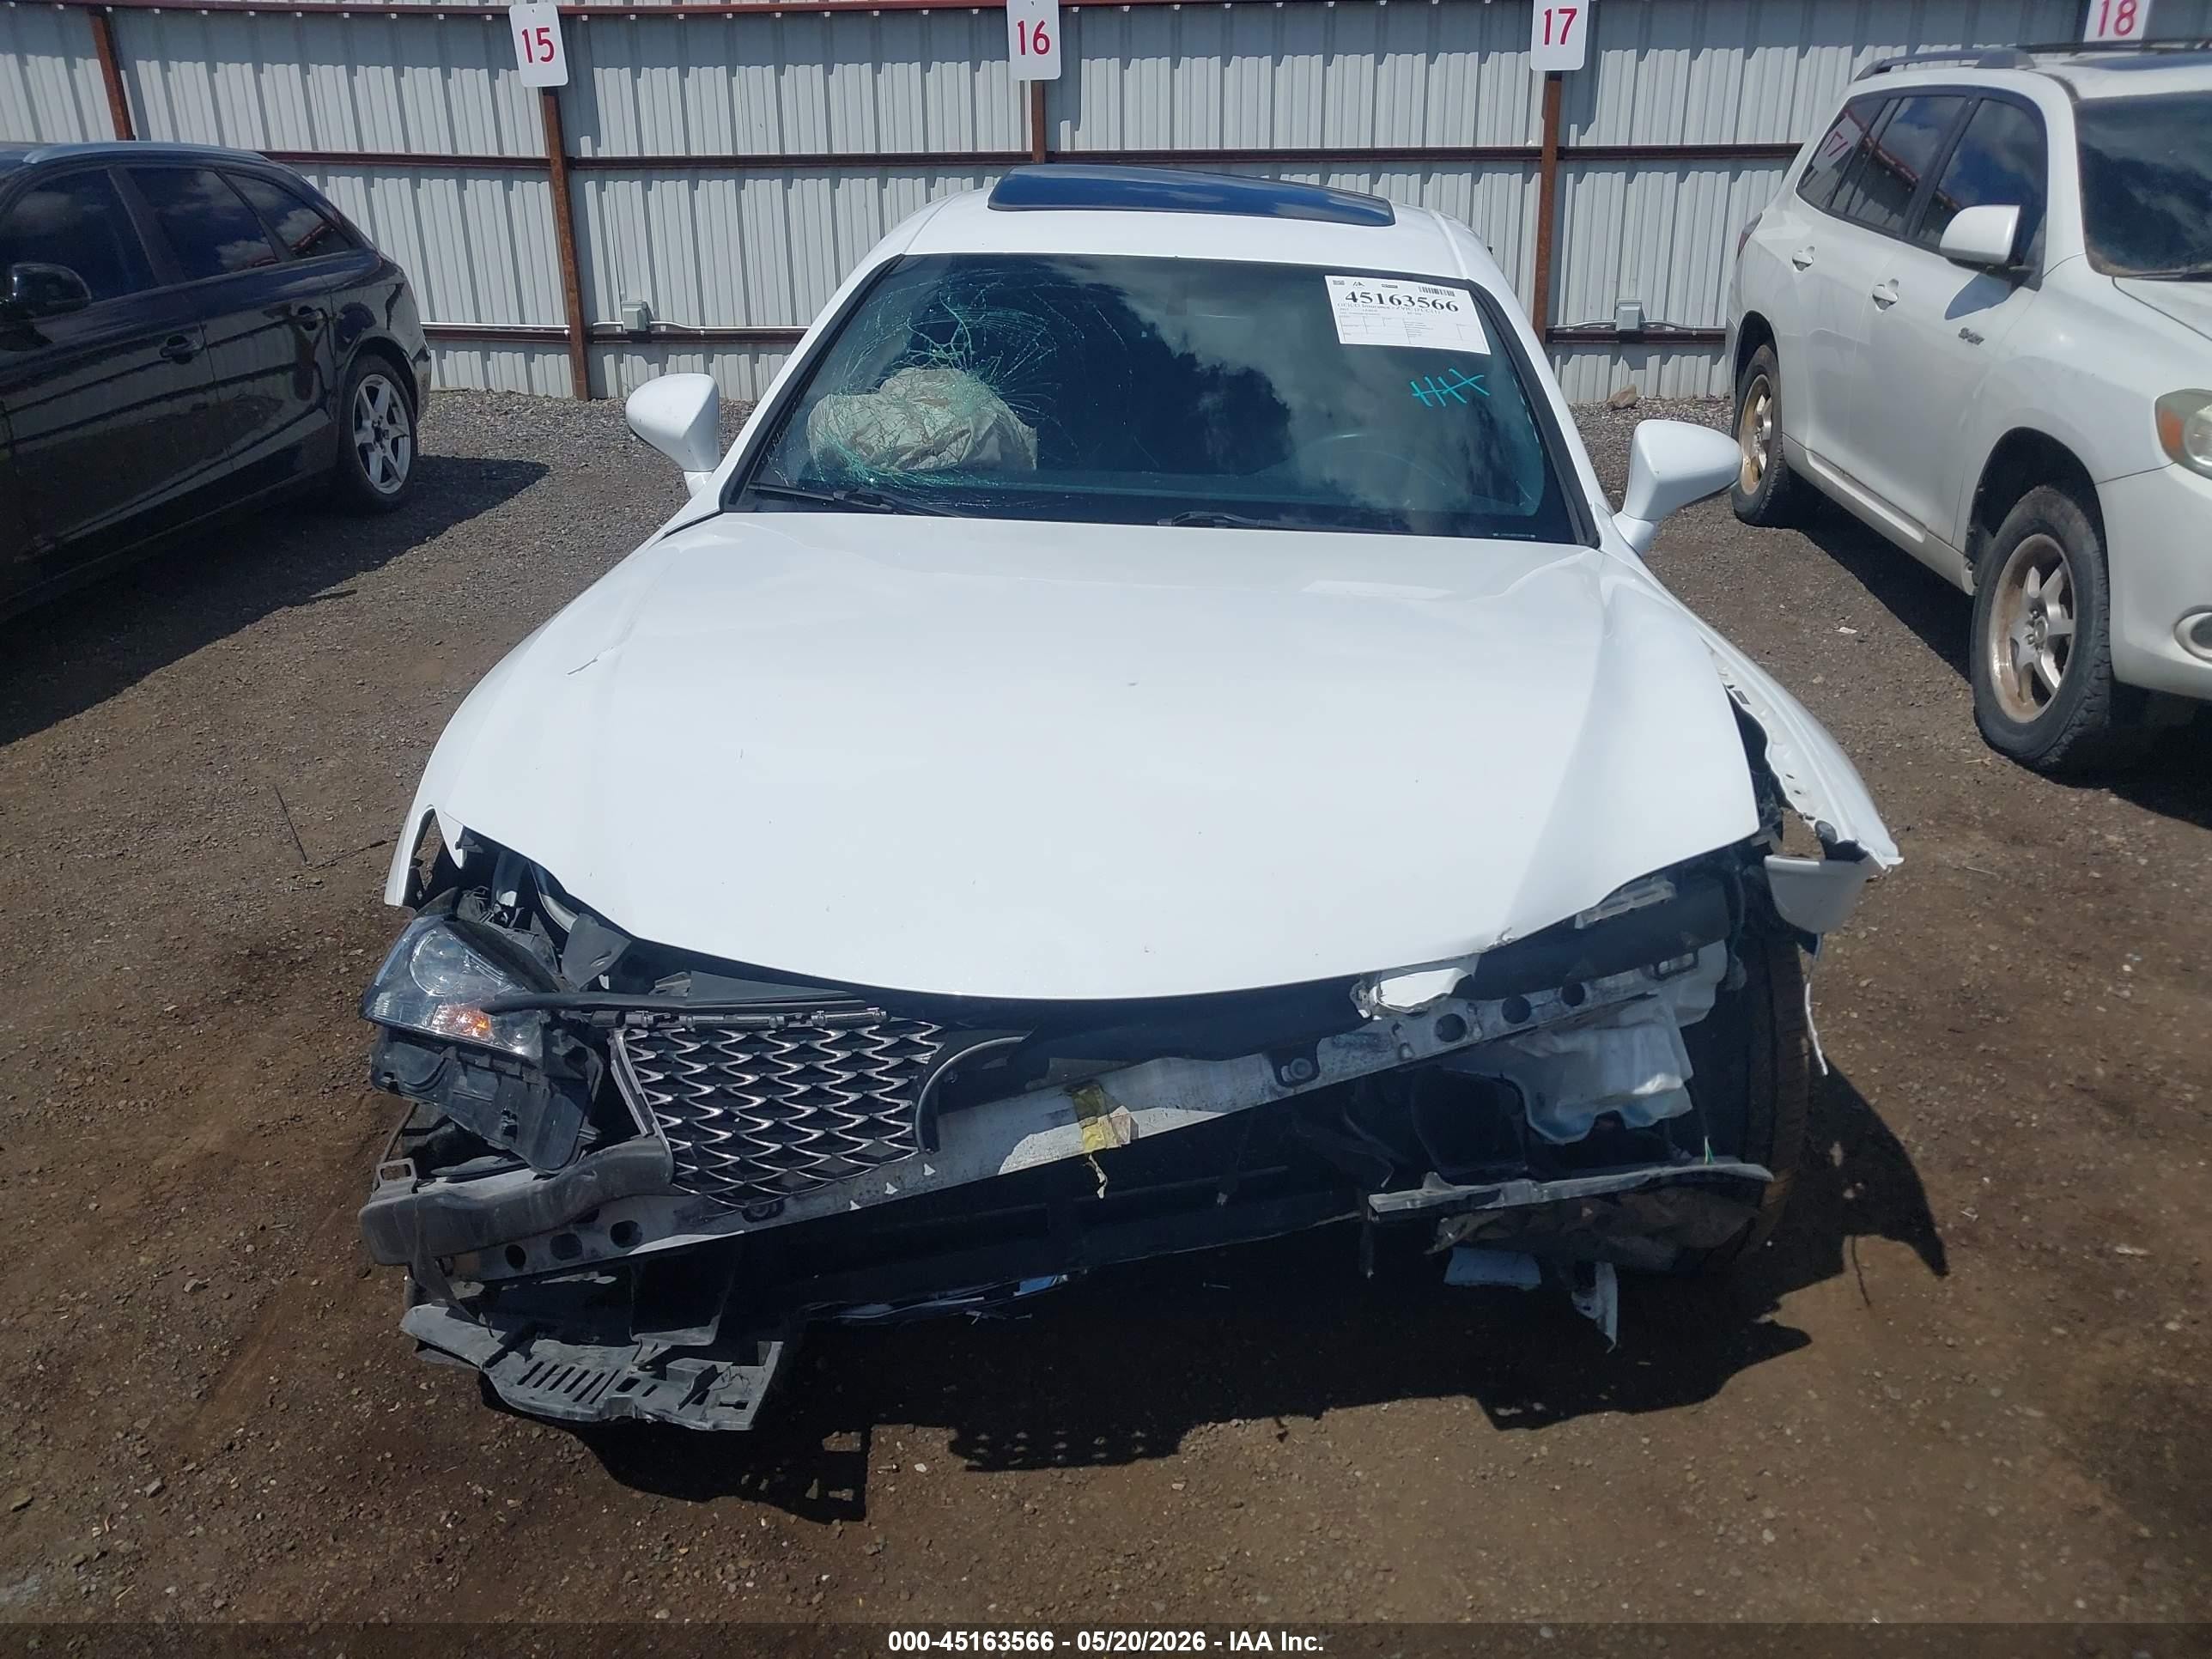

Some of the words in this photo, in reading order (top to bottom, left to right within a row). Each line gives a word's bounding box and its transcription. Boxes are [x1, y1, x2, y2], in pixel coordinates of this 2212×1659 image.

[1544, 8, 1577, 46] 17
[2098, 0, 2137, 37] 18
[521, 27, 555, 64] 15
[1017, 20, 1050, 56] 16
[1345, 290, 1459, 313] 45163566
